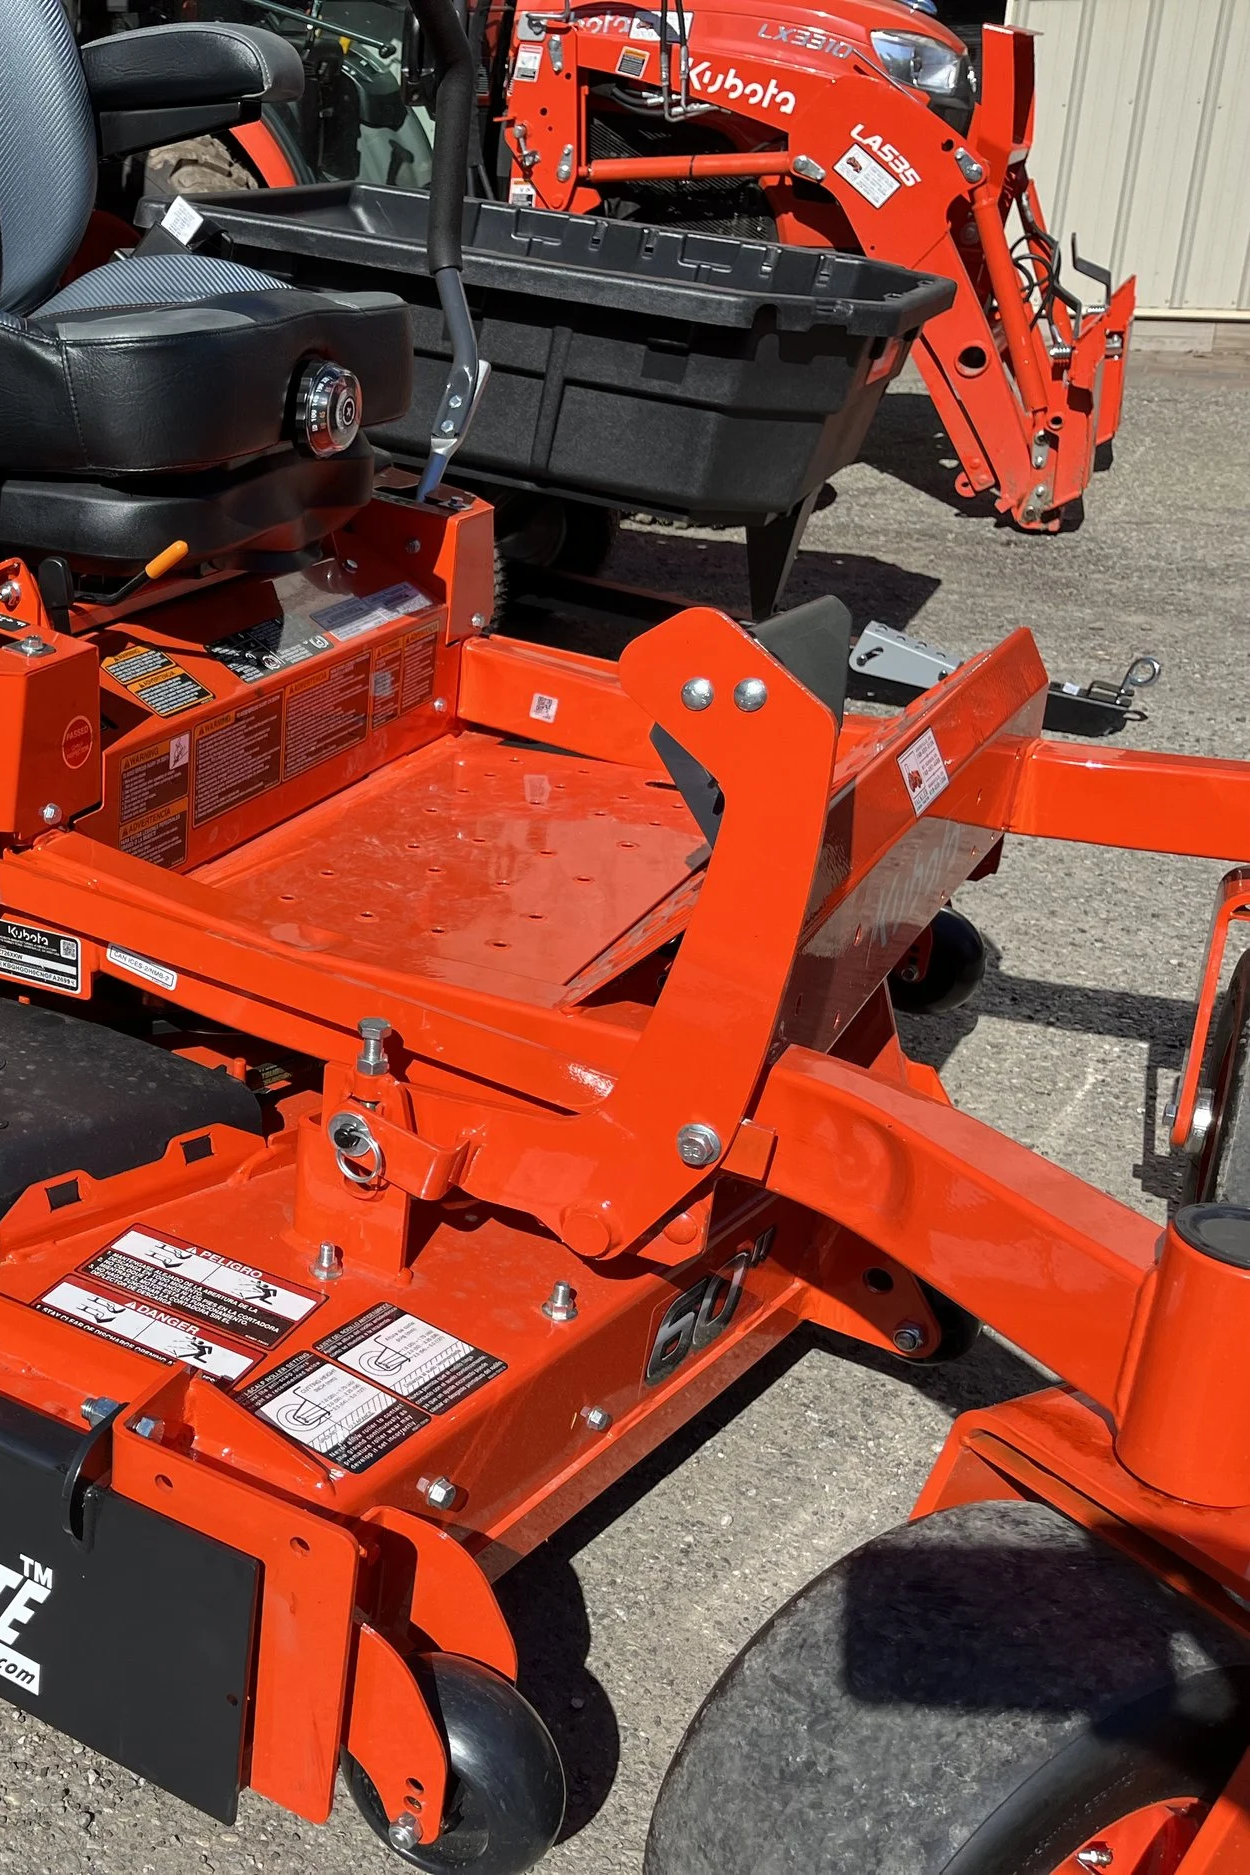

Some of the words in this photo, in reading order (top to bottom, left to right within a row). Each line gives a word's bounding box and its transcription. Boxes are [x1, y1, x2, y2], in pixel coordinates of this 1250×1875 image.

[757, 23, 854, 59] LX3310
[688, 57, 796, 115] Kubota
[850, 123, 922, 187] LA535
[66, 725, 89, 741] PASSED
[130, 746, 159, 766] WARNING
[130, 807, 171, 832] ADVERTENCIA
[7, 925, 49, 946] Kubota
[106, 1256, 143, 1272] DESCARGA
[150, 1273, 171, 1283] TODO
[168, 1280, 204, 1296] MOMENTO.
[198, 1250, 264, 1279] PELIGRO
[89, 1269, 130, 1287] DEFLECTOR
[136, 1288, 175, 1306] DESCARGA.
[97, 1262, 132, 1278] MIENTRAS
[138, 1278, 163, 1291] MOTOR
[188, 1299, 250, 1325] FUNCIONAMIENTO.
[103, 1270, 124, 1280] HAGA
[121, 1277, 160, 1295] FUNCIONAR
[167, 1296, 210, 1315] CORTADORA
[208, 1312, 225, 1321] SIN
[112, 1263, 145, 1278] COLOQUE
[142, 1275, 158, 1283] LAS
[155, 1280, 182, 1293] MANOS
[186, 1293, 203, 1301] LOS
[201, 1298, 219, 1307] PIES
[236, 1312, 281, 1332] CORTADORA
[152, 1269, 184, 1283] ALEJADO
[201, 1288, 239, 1305] ABERTURA
[135, 1304, 201, 1334] DANGER
[263, 1366, 288, 1382] ROLLER
[284, 1352, 310, 1368] SETTING
[327, 1443, 348, 1457] Never
[359, 1421, 378, 1434] roller
[381, 1402, 404, 1418] contact
[335, 1452, 349, 1462] the
[345, 1438, 368, 1454] ground
[364, 1414, 401, 1440] continuously
[342, 1443, 374, 1466] premature
[369, 1432, 389, 1445] roller
[385, 1422, 402, 1434] wear
[398, 1413, 414, 1424] may
[348, 1451, 376, 1470] develop
[375, 1440, 390, 1450] set
